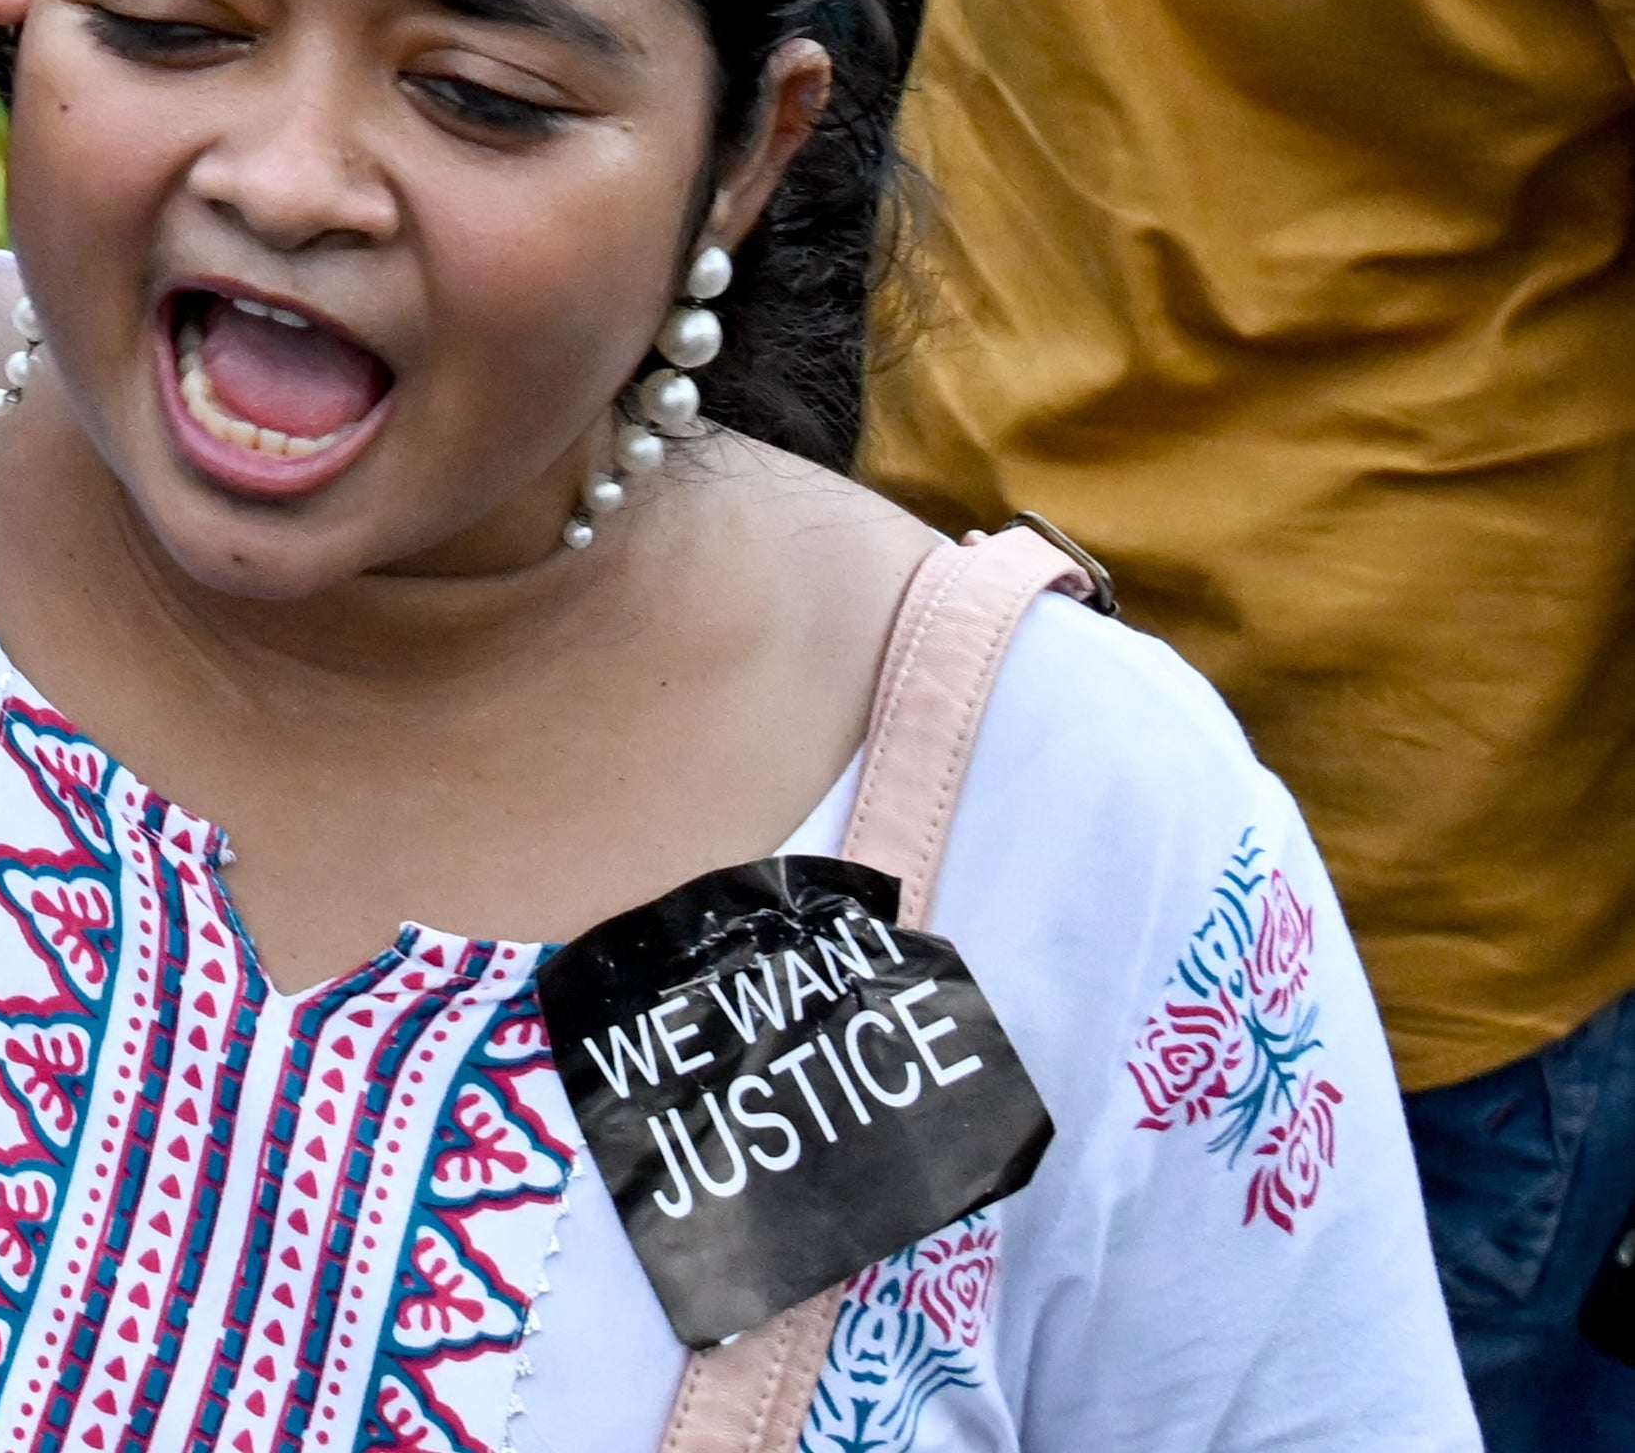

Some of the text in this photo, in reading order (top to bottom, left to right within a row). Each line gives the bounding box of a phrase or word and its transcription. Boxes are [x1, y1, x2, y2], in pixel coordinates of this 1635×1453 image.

[583, 911, 906, 1100] WE WANT
[646, 978, 985, 1220] JUSTICE
